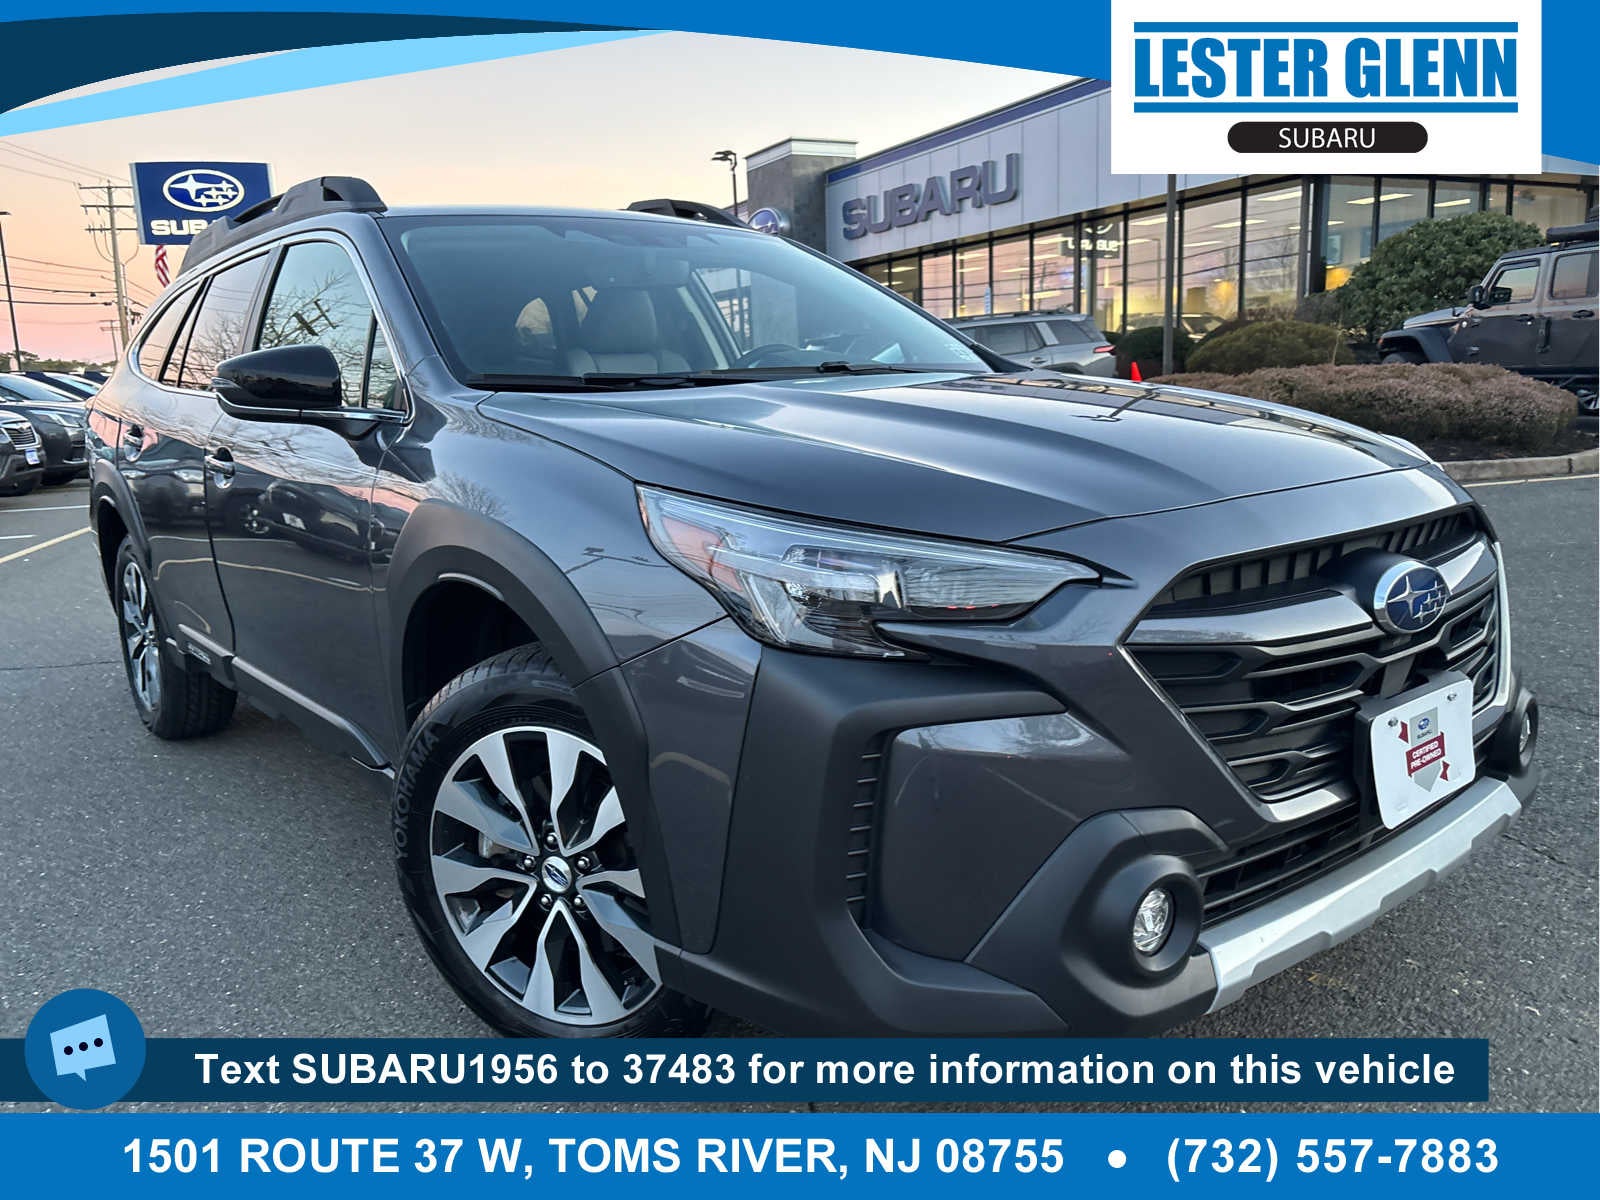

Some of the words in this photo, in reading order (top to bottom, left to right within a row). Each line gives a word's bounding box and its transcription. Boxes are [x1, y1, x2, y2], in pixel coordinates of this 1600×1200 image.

[842, 153, 1020, 241] SUBARU
[150, 219, 211, 236] SUB
[1410, 748, 1442, 769] PRE-OWNED
[1412, 740, 1439, 759] CERTIFIED
[394, 726, 439, 859] YOKOHAMA
